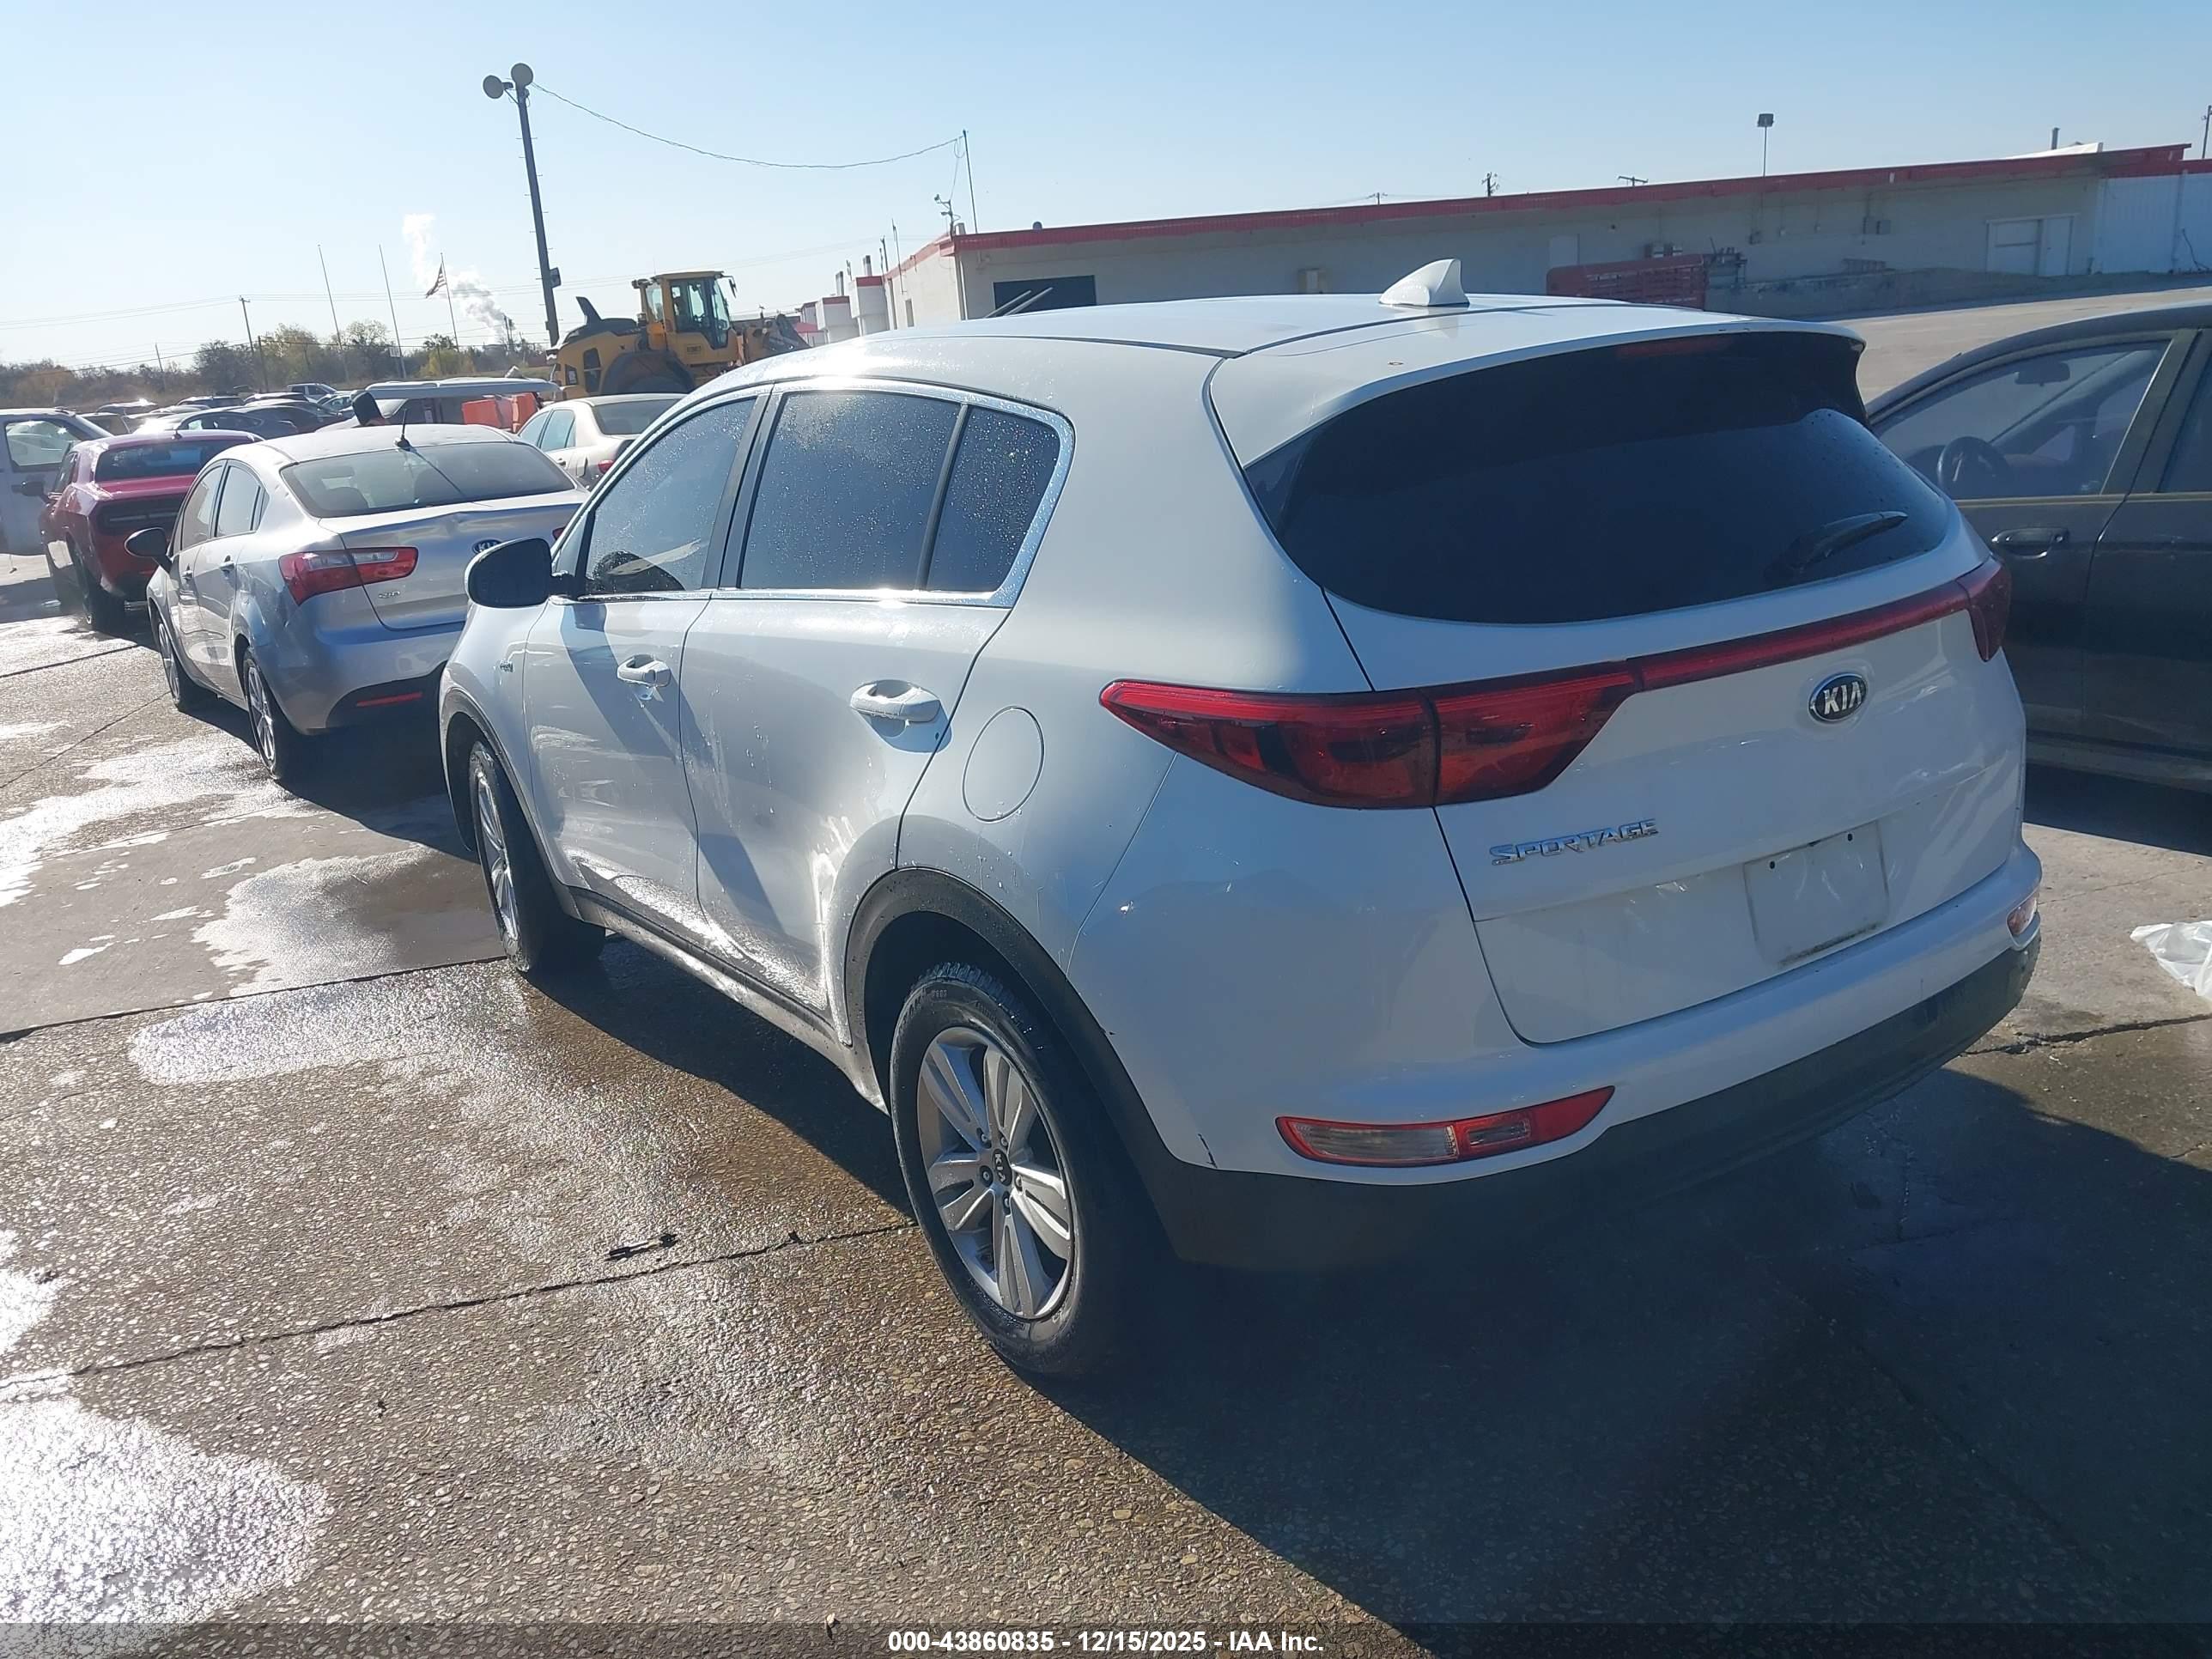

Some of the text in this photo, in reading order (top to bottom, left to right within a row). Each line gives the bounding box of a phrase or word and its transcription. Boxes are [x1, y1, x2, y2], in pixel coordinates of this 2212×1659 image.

[1823, 681, 1862, 715] KIA
[1489, 818, 1659, 866] SPORTAGE
[994, 1153, 1006, 1182] KIA
